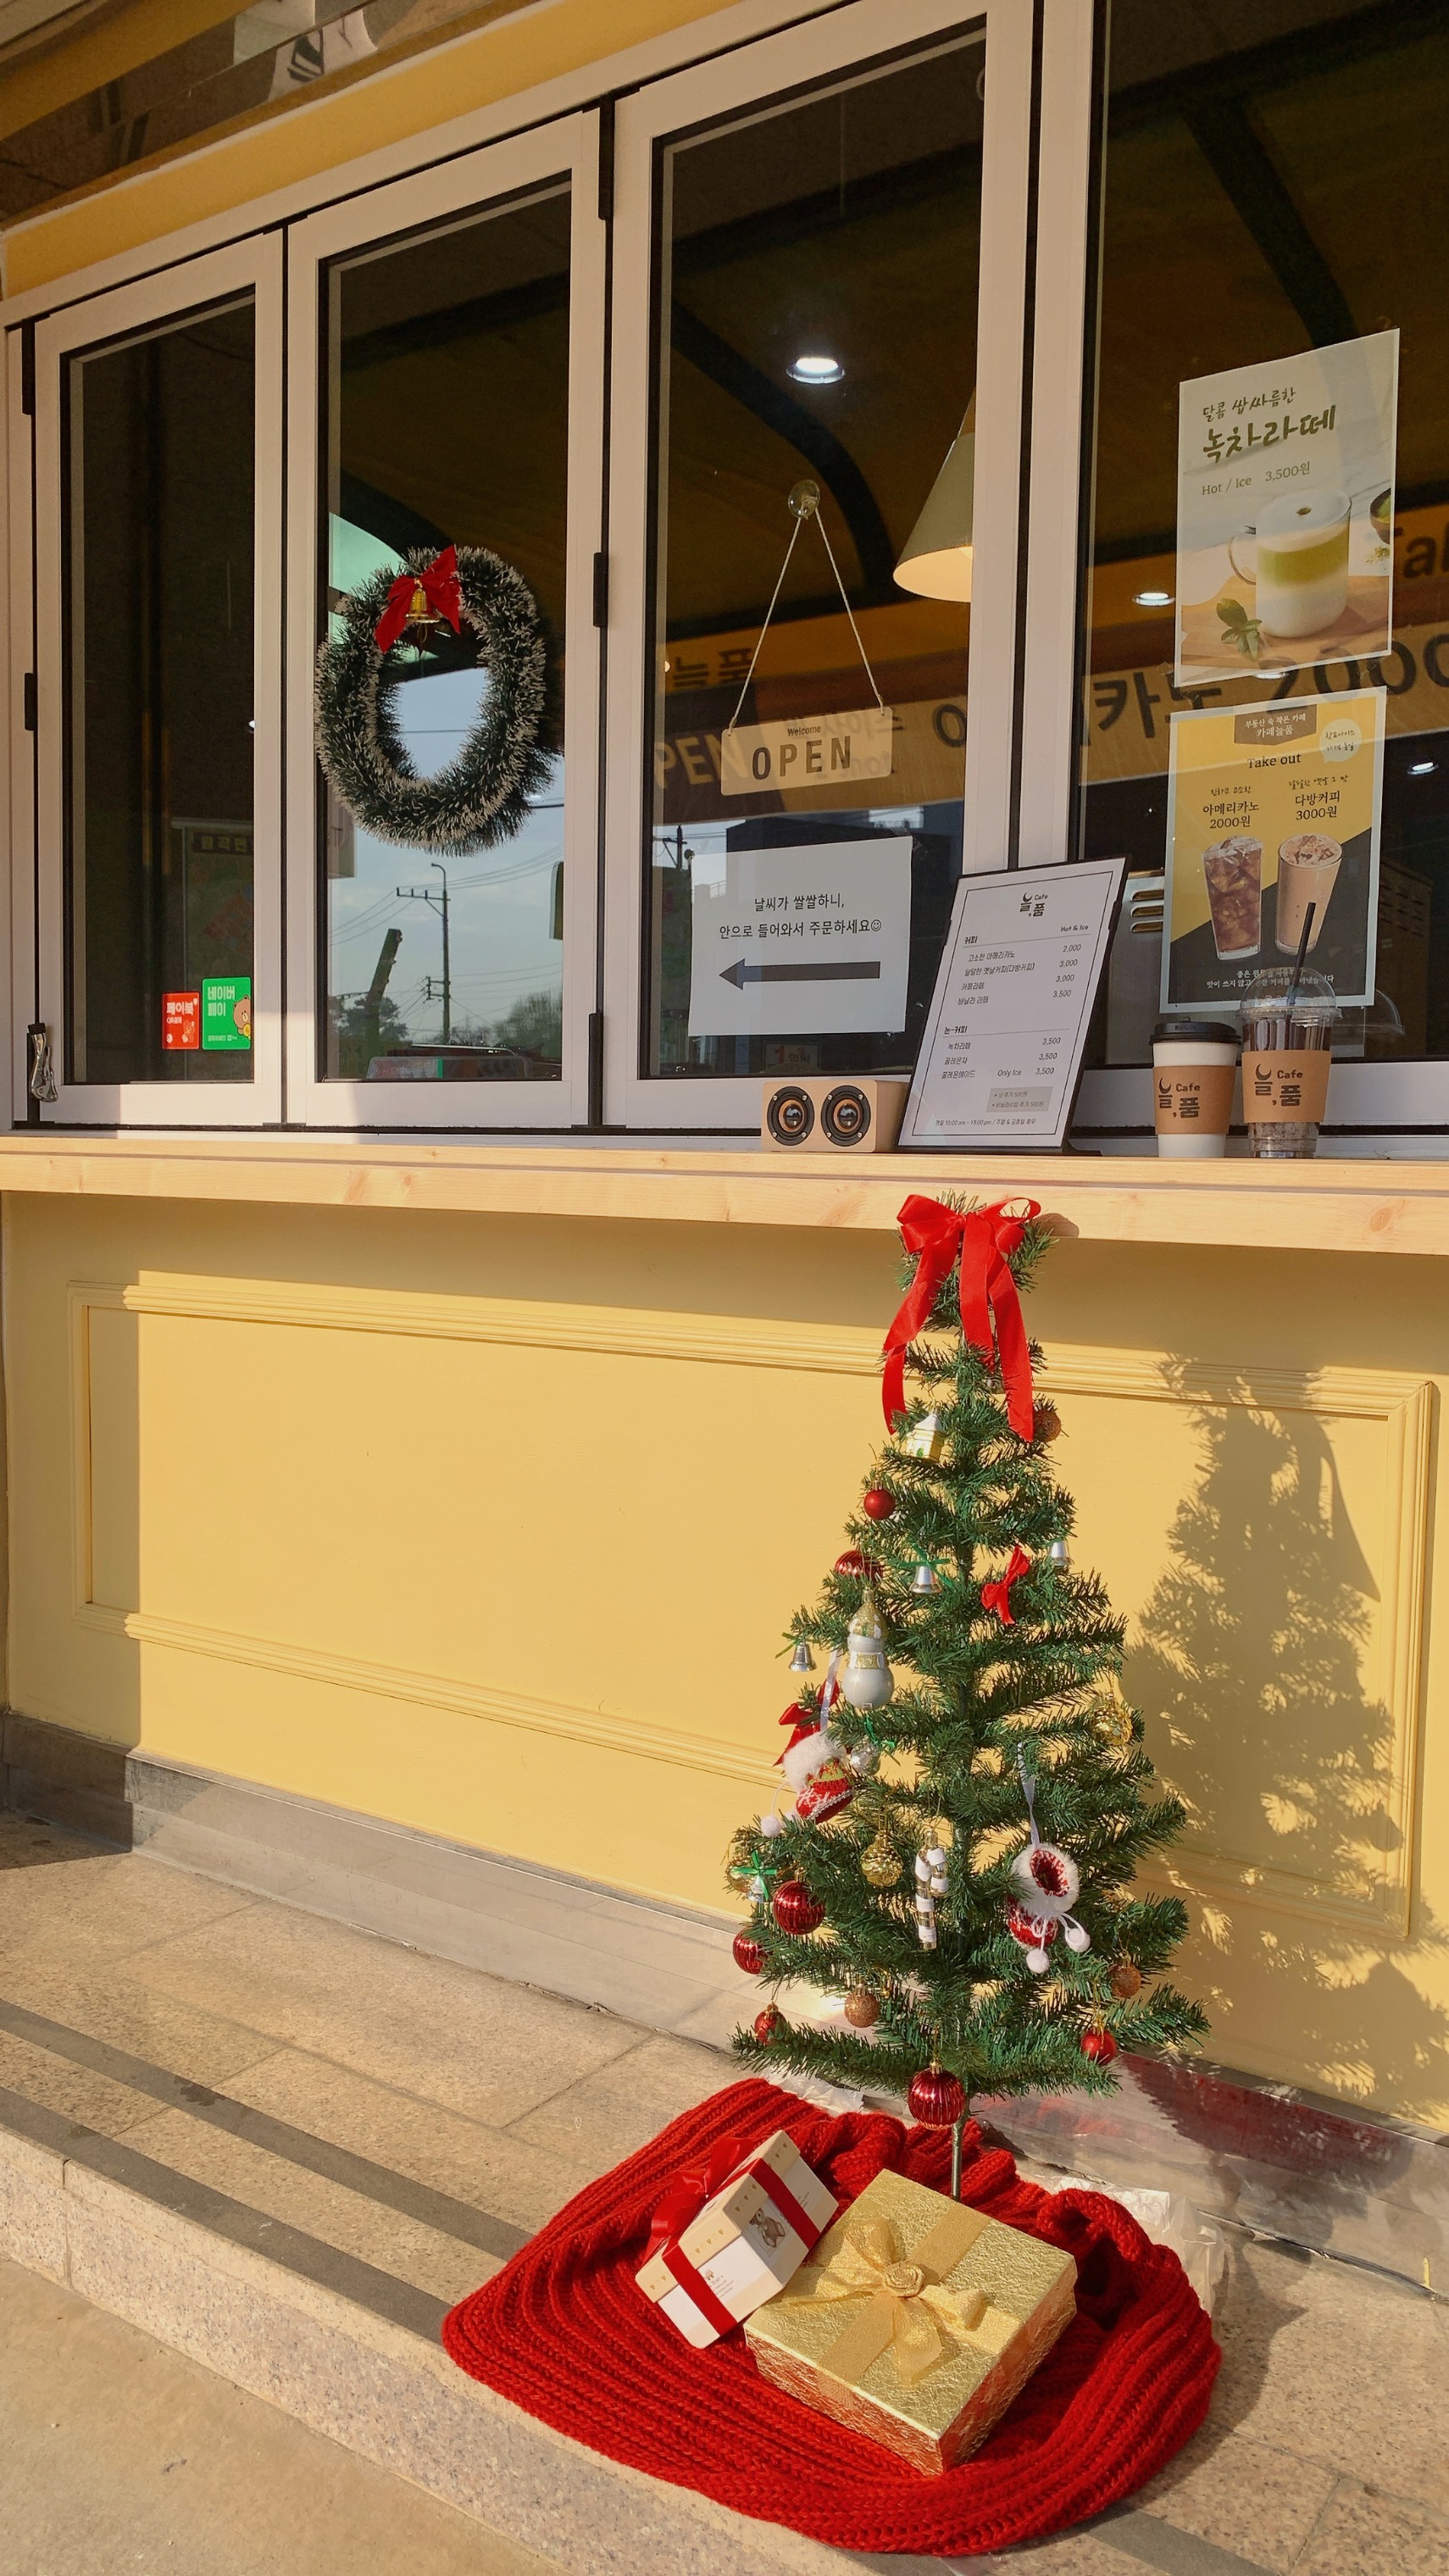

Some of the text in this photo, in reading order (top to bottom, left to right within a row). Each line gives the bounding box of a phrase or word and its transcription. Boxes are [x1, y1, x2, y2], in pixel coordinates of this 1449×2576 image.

[1202, 387, 1296, 423] 달콤 쌉싸름한
[1203, 405, 1336, 464] 녹차라떼
[1202, 482, 1222, 496] Hot
[1235, 475, 1252, 489] Ice
[1265, 462, 1311, 482] 3,500원
[1246, 719, 1265, 728] 부동산
[1276, 715, 1291, 724] 작은
[1292, 713, 1306, 722] 카페
[787, 724, 822, 737] Welcome
[752, 736, 852, 780] OPEN
[1247, 753, 1302, 769] Take out
[1295, 791, 1341, 807] 다방커피
[1203, 801, 1259, 816] 아메리카노
[1296, 806, 1337, 820] 3000원
[1210, 815, 1251, 829] 2000원
[755, 893, 845, 912] 날씨가 쌀쌀하니,
[720, 919, 870, 939] 안으로 들어와서 주문하세요
[986, 951, 1015, 959] 아메리카노
[1063, 944, 1081, 952] 2,000
[1059, 959, 1078, 968] 3,000
[1056, 974, 1074, 983] 3,000
[208, 985, 236, 1000] 네이버
[1052, 990, 1071, 998] 3,500
[208, 1002, 226, 1016] 페이
[1042, 1037, 1061, 1046] 3,500
[997, 1069, 1010, 1078] Only
[1277, 1070, 1303, 1079] Cafe
[1175, 1083, 1201, 1092] Cafe
